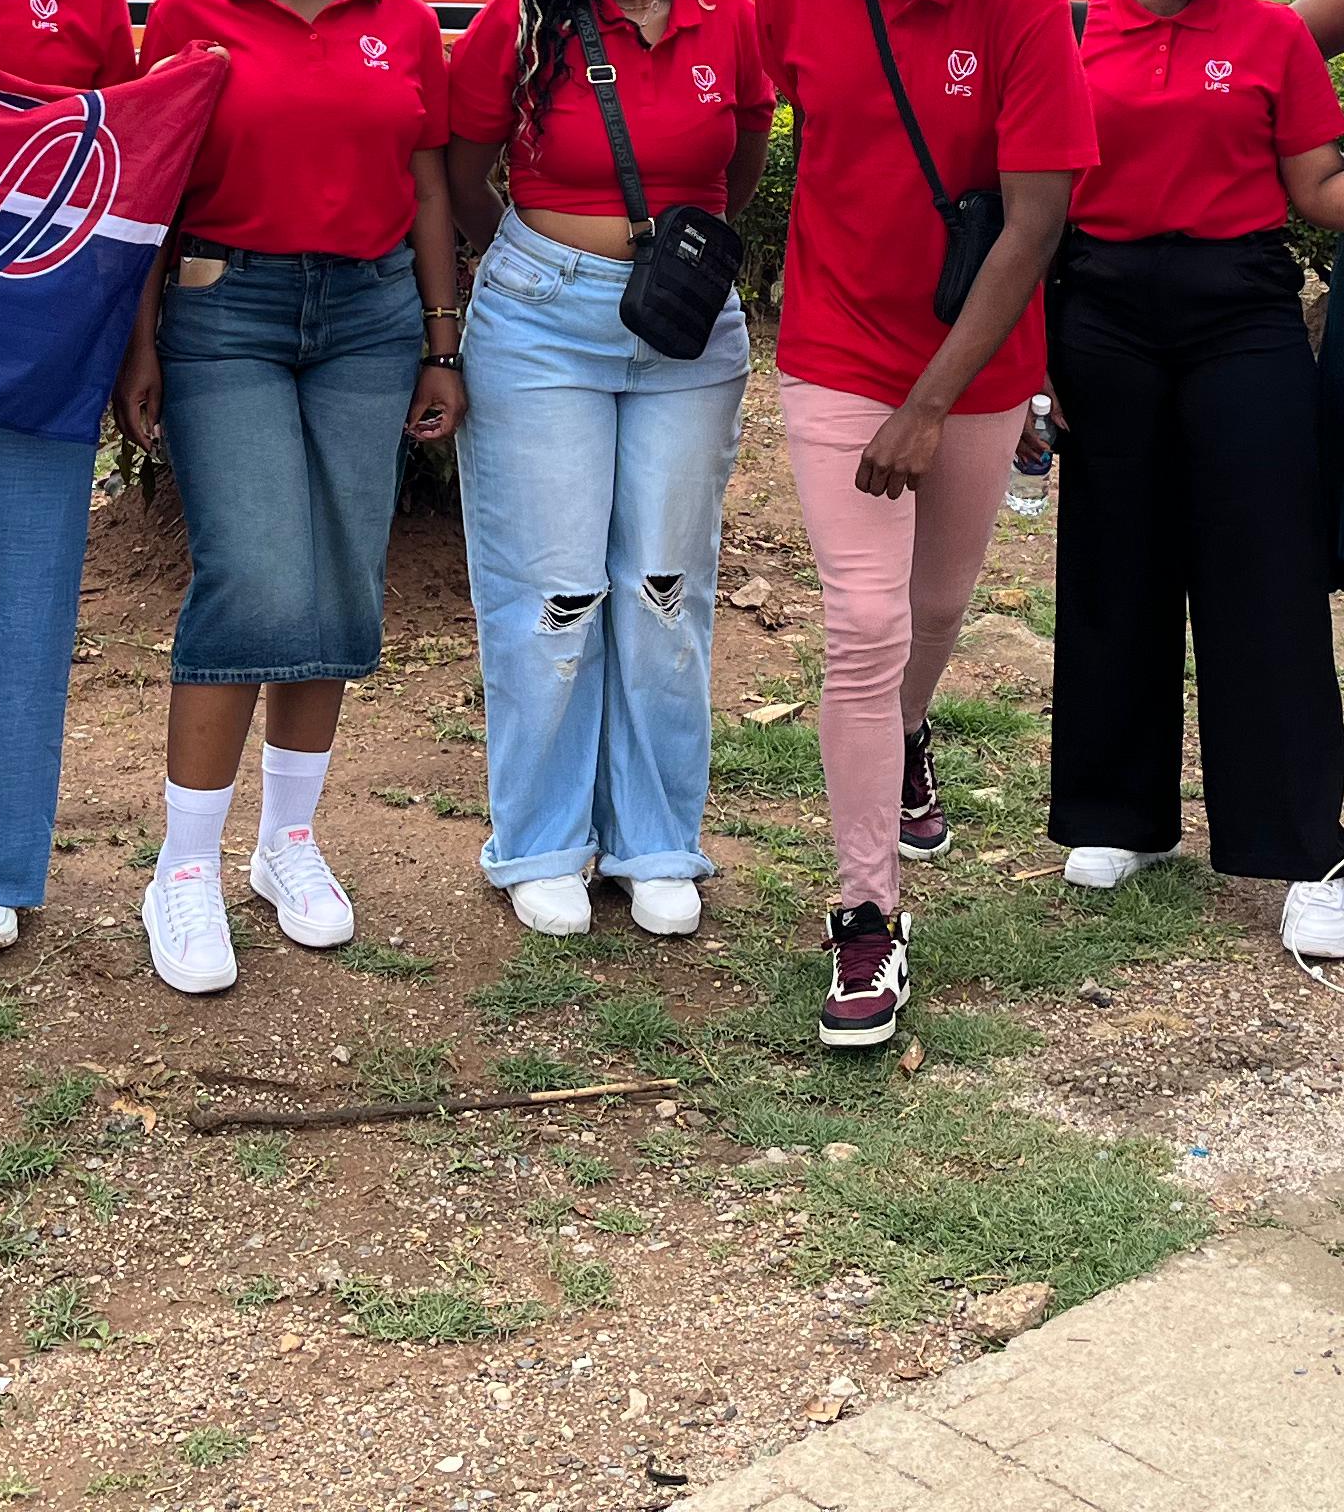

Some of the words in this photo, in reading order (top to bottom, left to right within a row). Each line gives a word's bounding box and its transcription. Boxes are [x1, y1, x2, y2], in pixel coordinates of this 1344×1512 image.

[32, 19, 58, 32] UFS
[363, 57, 389, 70] UFS
[944, 82, 973, 97] UFS
[1204, 80, 1230, 93] UFS
[697, 92, 722, 104] UFS
